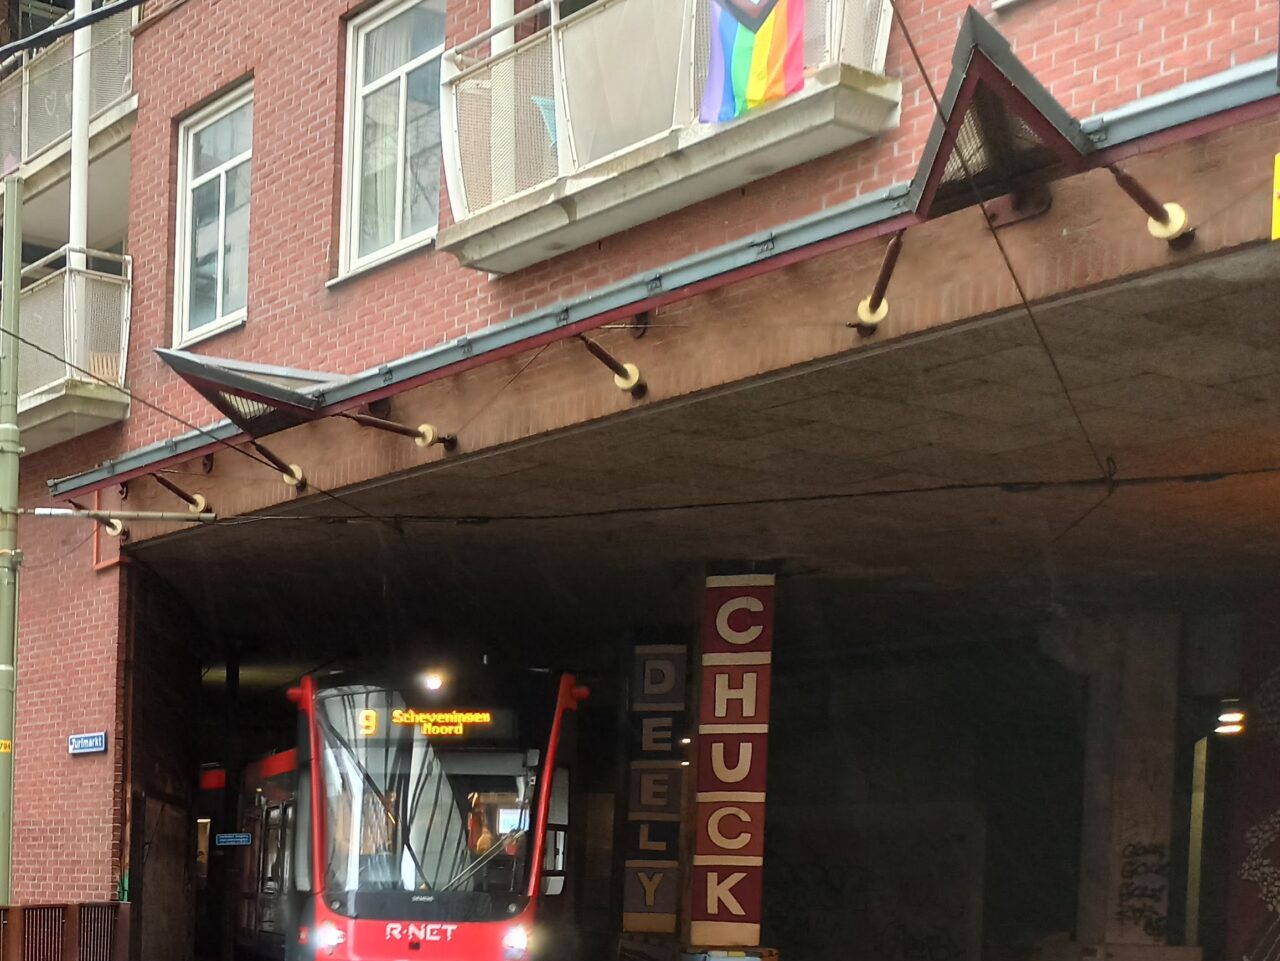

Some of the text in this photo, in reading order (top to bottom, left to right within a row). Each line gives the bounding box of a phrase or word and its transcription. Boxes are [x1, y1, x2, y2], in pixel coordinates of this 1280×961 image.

[358, 708, 377, 735] 9
[422, 722, 464, 735] Noord
[637, 659, 676, 907] DEELY
[704, 595, 765, 916] CHUCK
